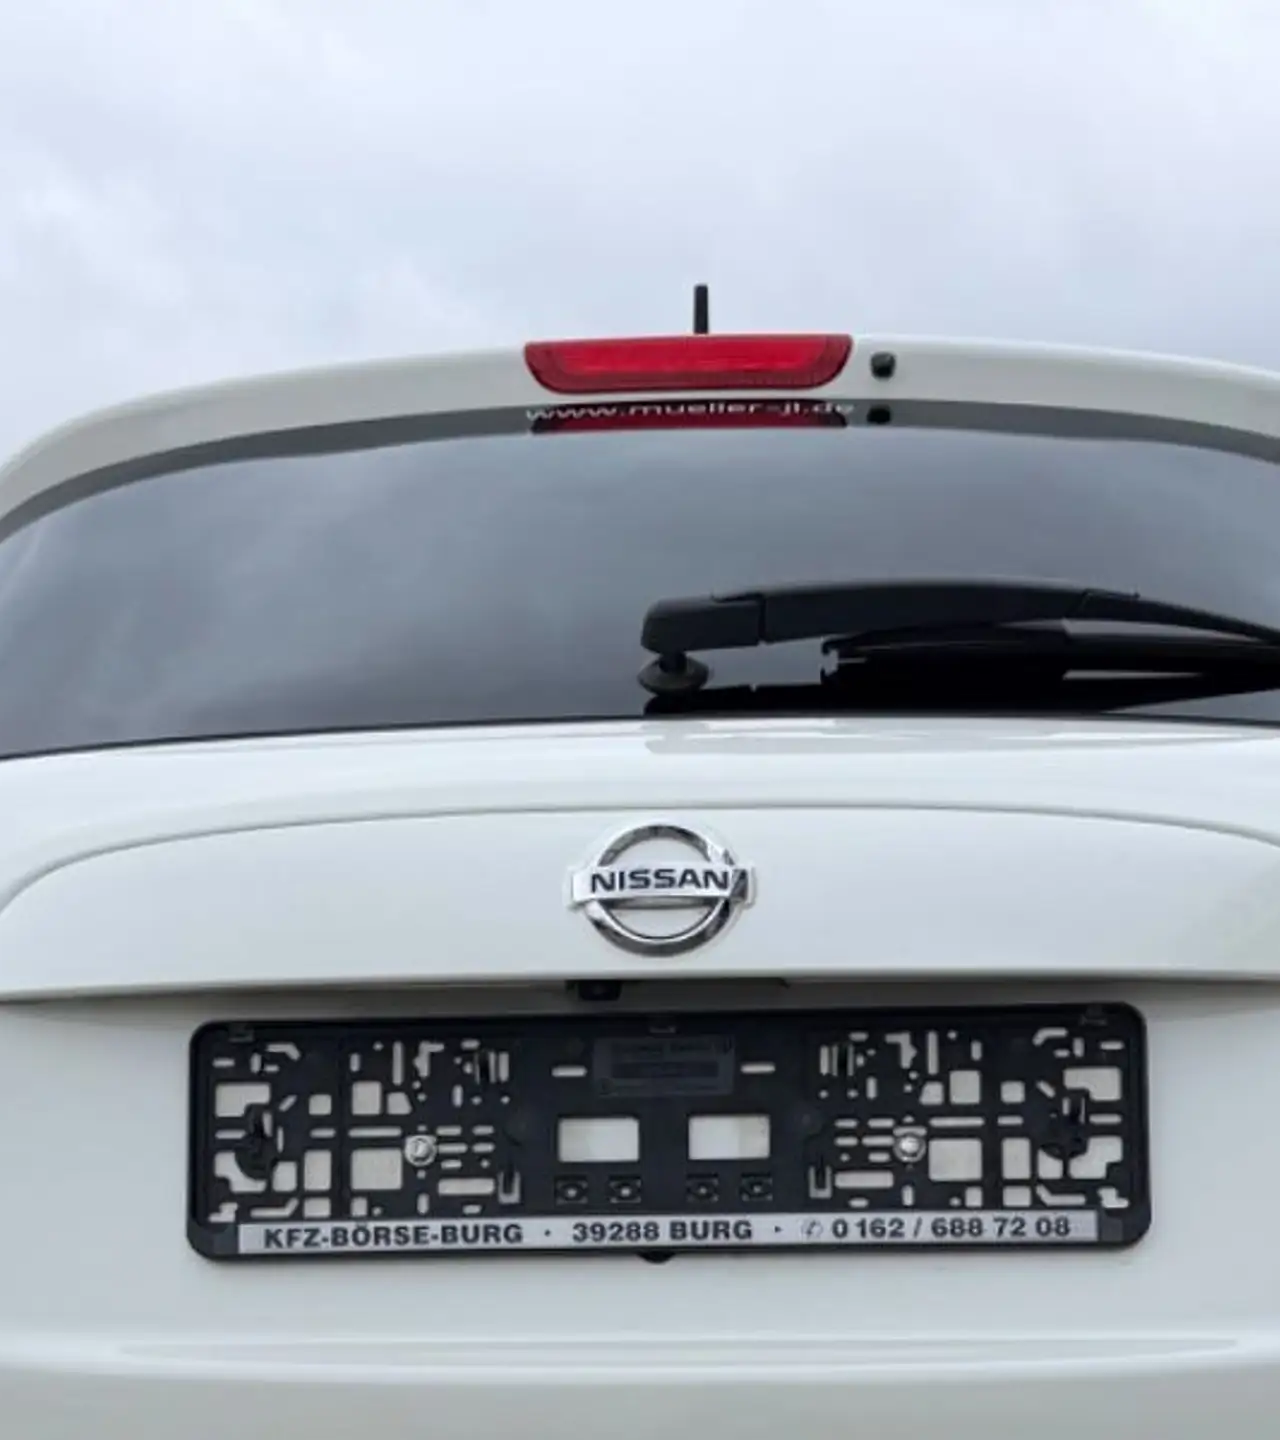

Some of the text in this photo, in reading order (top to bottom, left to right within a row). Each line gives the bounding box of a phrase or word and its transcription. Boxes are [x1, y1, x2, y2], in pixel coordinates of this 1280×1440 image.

[591, 868, 729, 893] NISSAN
[264, 1220, 523, 1249] KFZ-BÖRSE-BURG
[572, 1221, 661, 1243] 39288
[670, 1219, 753, 1241] BURG
[930, 1216, 983, 1238] 688
[993, 1216, 1027, 1238] 72
[1035, 1216, 1070, 1237] 08
